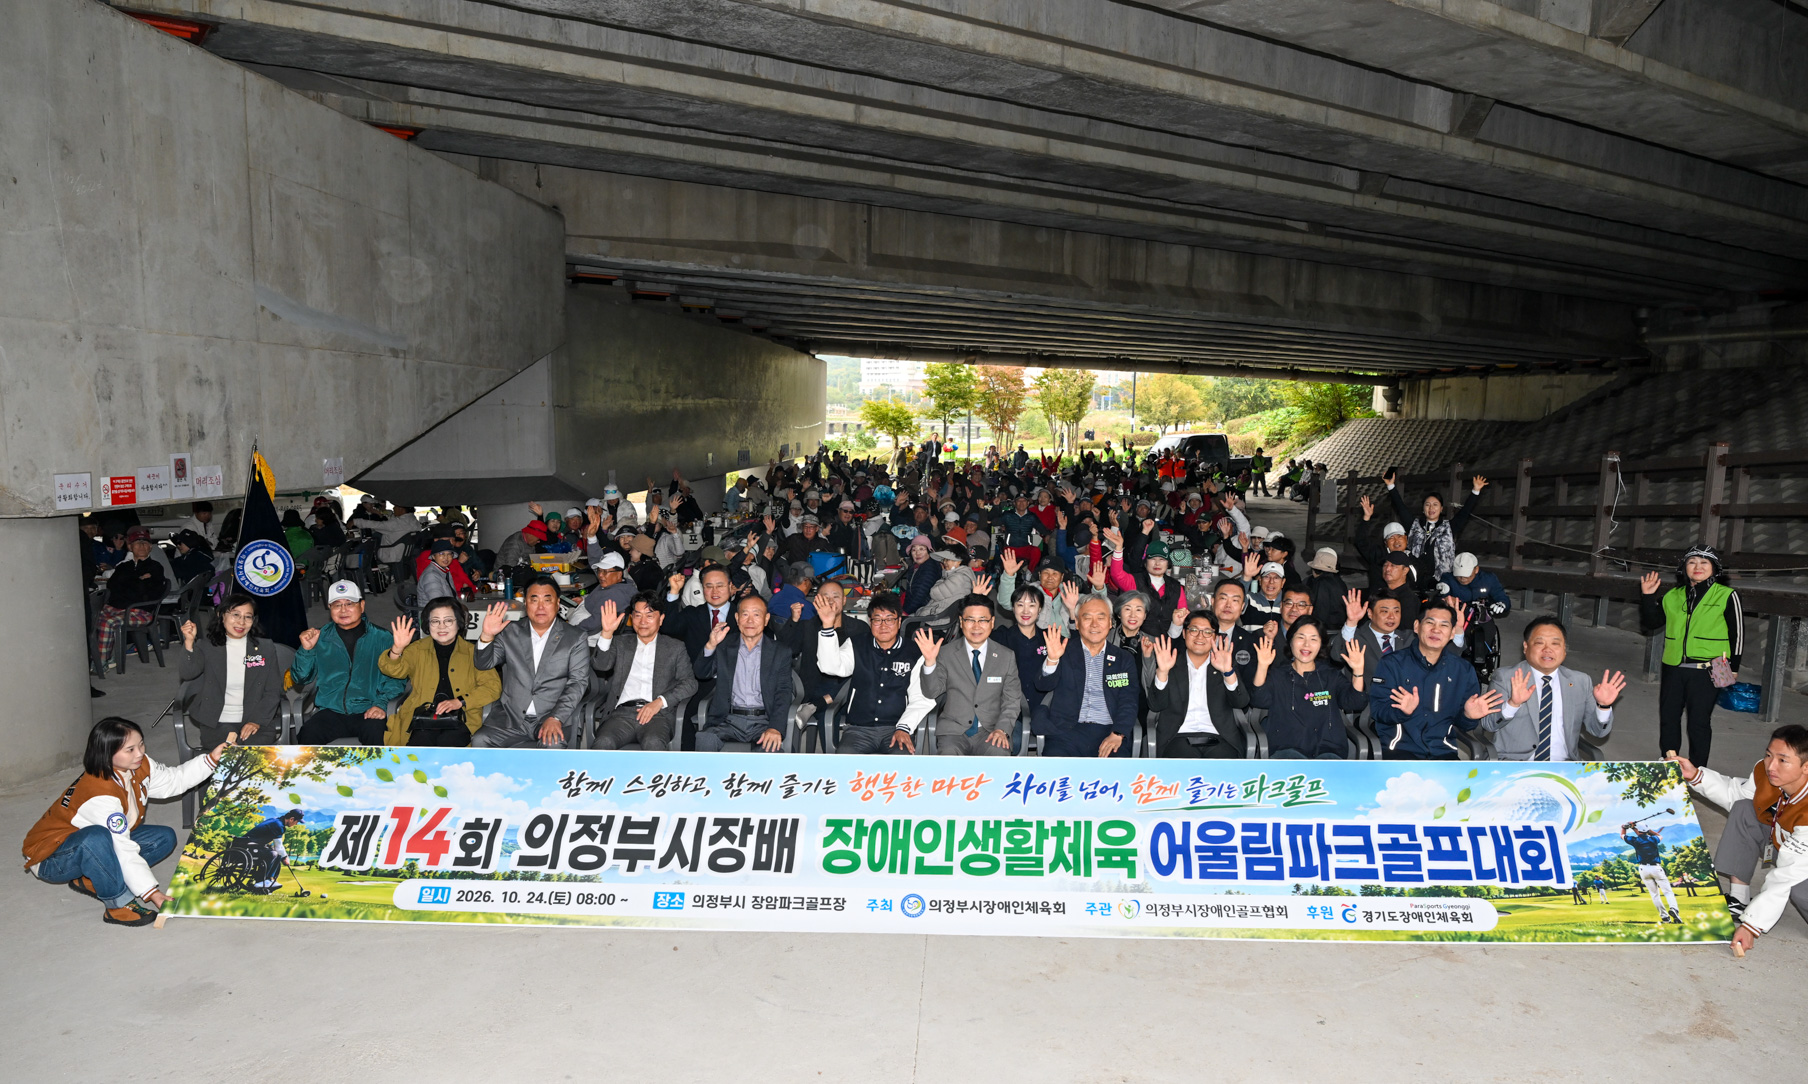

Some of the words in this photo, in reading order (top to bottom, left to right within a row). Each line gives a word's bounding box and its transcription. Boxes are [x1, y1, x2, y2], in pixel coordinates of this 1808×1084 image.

[195, 475, 221, 487] 머리조심
[893, 662, 910, 673] UPG
[558, 770, 614, 798] 함께
[622, 774, 711, 798] 스윙하고,
[722, 773, 773, 799] 함께
[779, 774, 838, 800] 즐기는
[849, 770, 924, 805] 행복한
[931, 773, 992, 803] 마당
[1003, 772, 1072, 805] 차이를
[1078, 779, 1124, 803] 넘어,
[1130, 774, 1180, 804] 함께
[1186, 776, 1236, 804] 즐기는
[1242, 774, 1327, 807] 파크골프
[327, 806, 502, 869] 제14회
[517, 813, 800, 874] 의정부시장배
[821, 818, 1139, 880] 장애인생활체육
[1149, 820, 1567, 885] 어울림파크골프대회
[421, 887, 449, 904] 일시
[456, 889, 495, 903] 2026.
[502, 891, 521, 904] 10.
[526, 891, 571, 907] 24.(토)
[577, 892, 616, 905] 08:00
[656, 892, 684, 909] 장소
[692, 894, 746, 909] 의정부시
[751, 894, 847, 912] 장암파크골프장
[866, 898, 893, 913] 주최
[928, 899, 1067, 916] 의정부시장애인체육회
[1085, 902, 1112, 917] 주관
[1145, 902, 1289, 919] 의정부시장애인골프협회
[1306, 905, 1334, 921] 후원
[1361, 909, 1474, 924] 경기도장애인체육회
